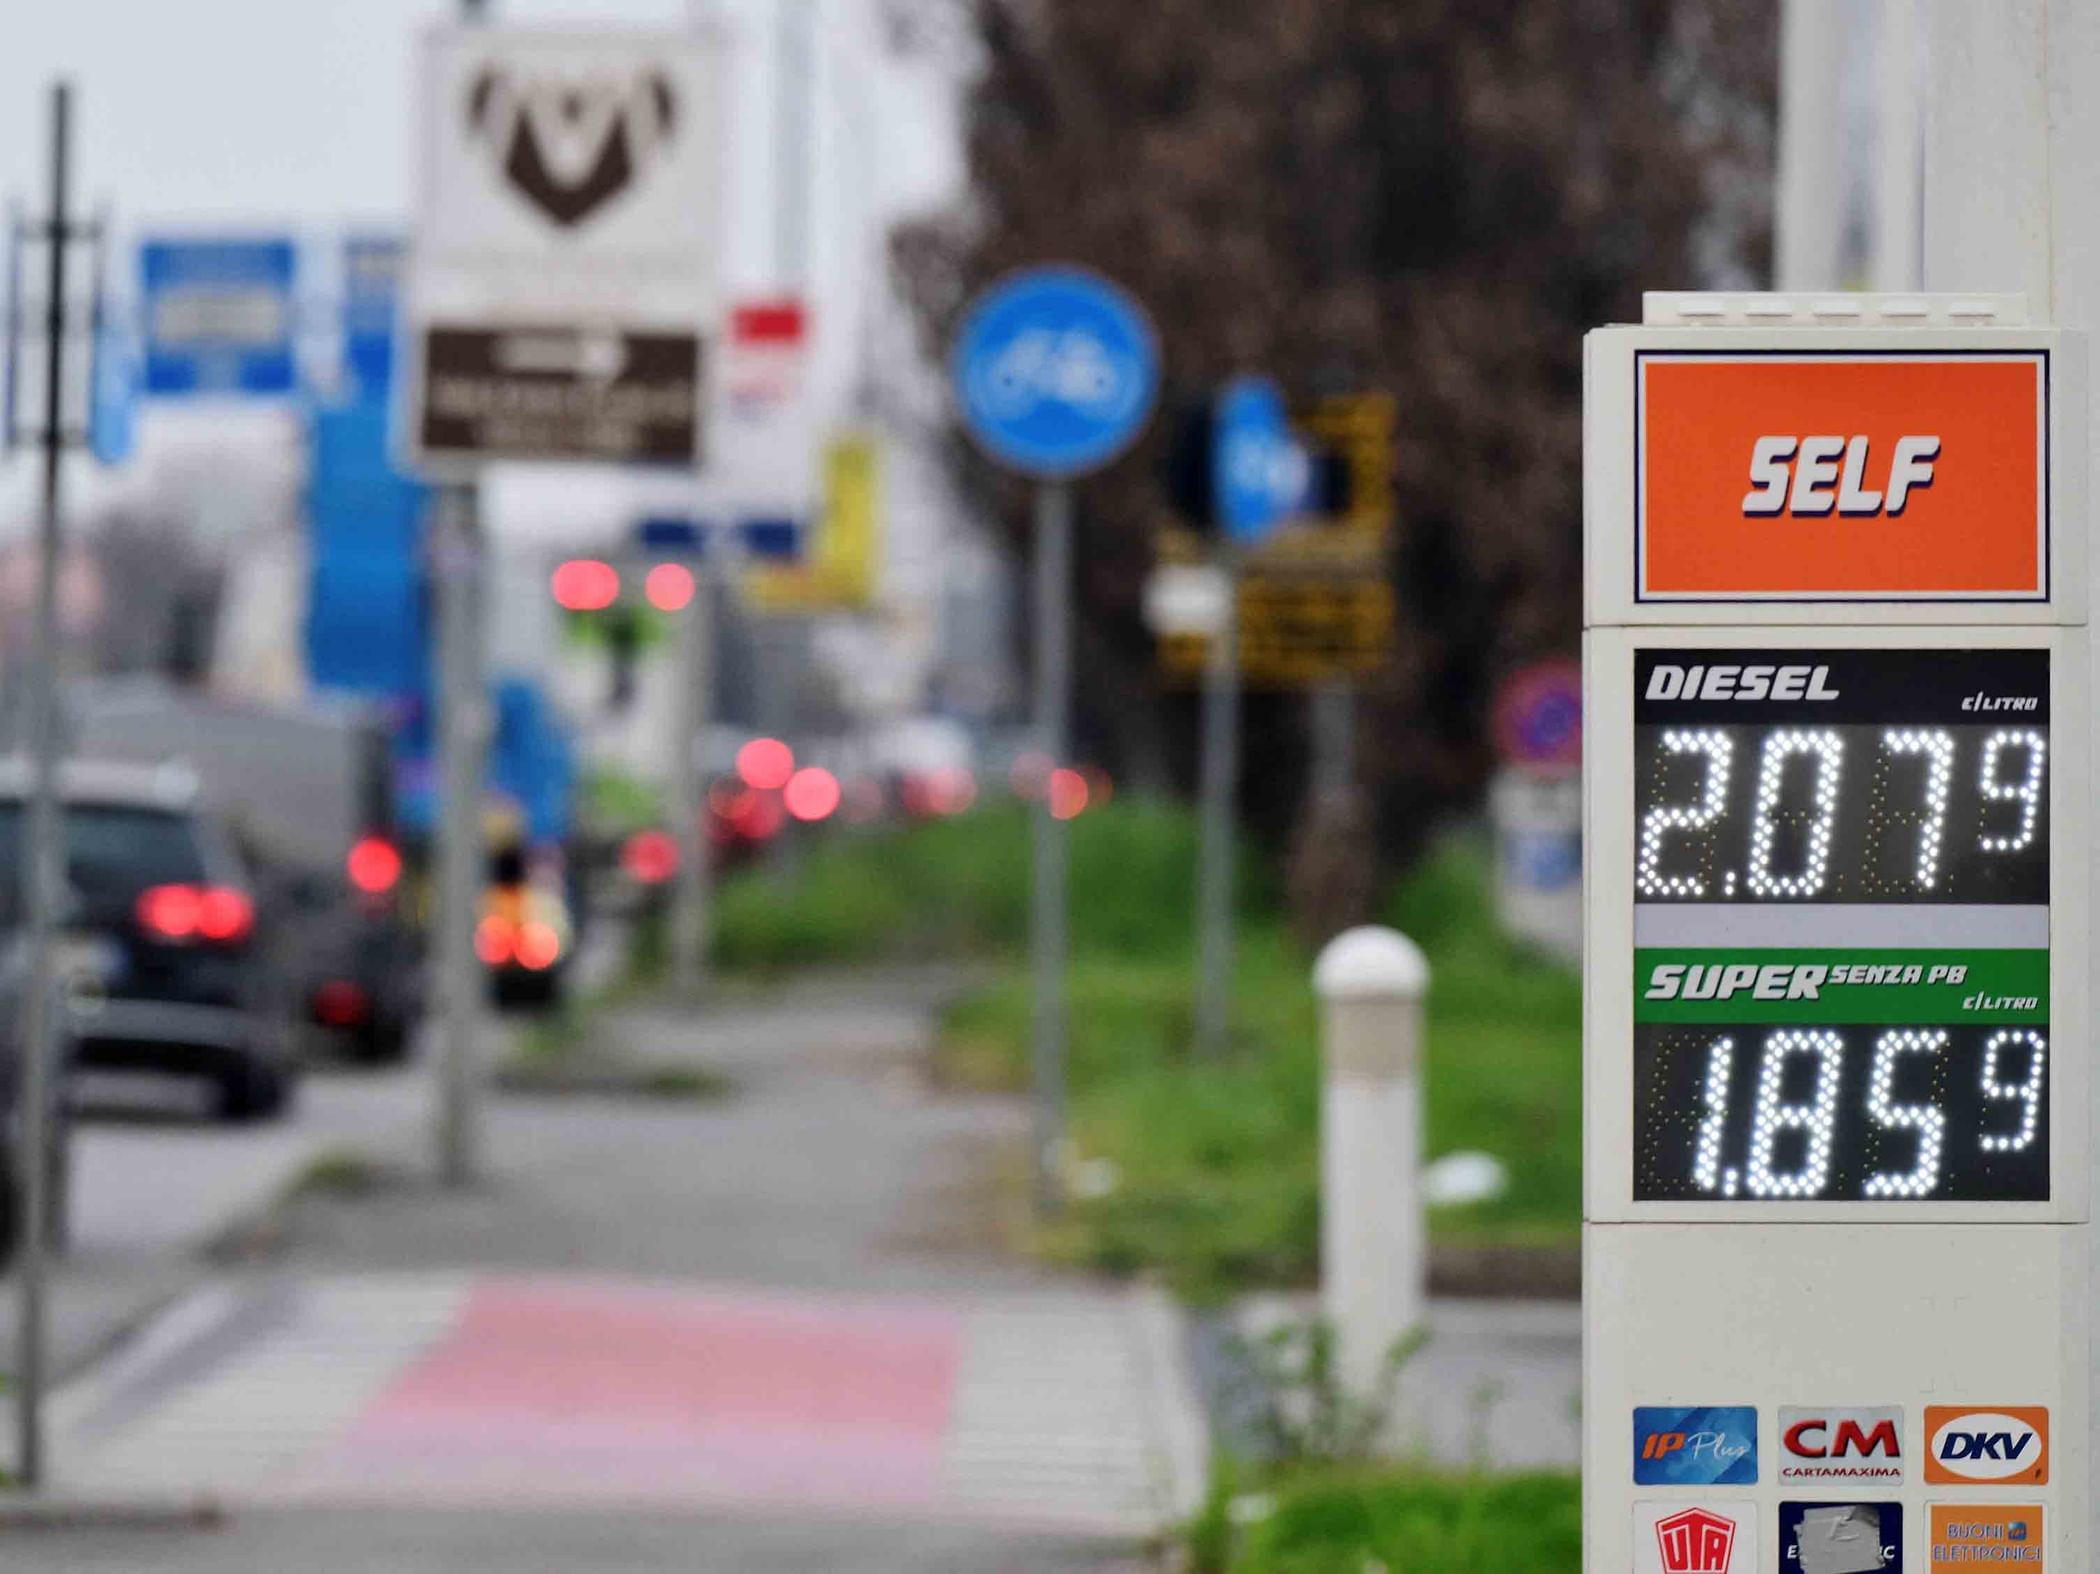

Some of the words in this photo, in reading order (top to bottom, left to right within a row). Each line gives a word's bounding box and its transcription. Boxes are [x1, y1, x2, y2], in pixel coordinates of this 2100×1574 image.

[1742, 435, 1941, 517] SELF
[1645, 665, 1840, 701] DIESEL
[1644, 964, 1829, 1001] SUPER
[1829, 964, 1924, 985] SENZA
[1641, 1432, 1687, 1460] IP
[1687, 1431, 1750, 1461] Plus
[1783, 1418, 1901, 1459] CM
[1940, 1431, 2033, 1460] DKV
[1782, 1466, 1902, 1477] CARTAMAXIMA
[1661, 1510, 1730, 1572] UTA
[1947, 1522, 2004, 1540] BUONI
[1932, 1544, 2041, 1561] ELETTRONICI
